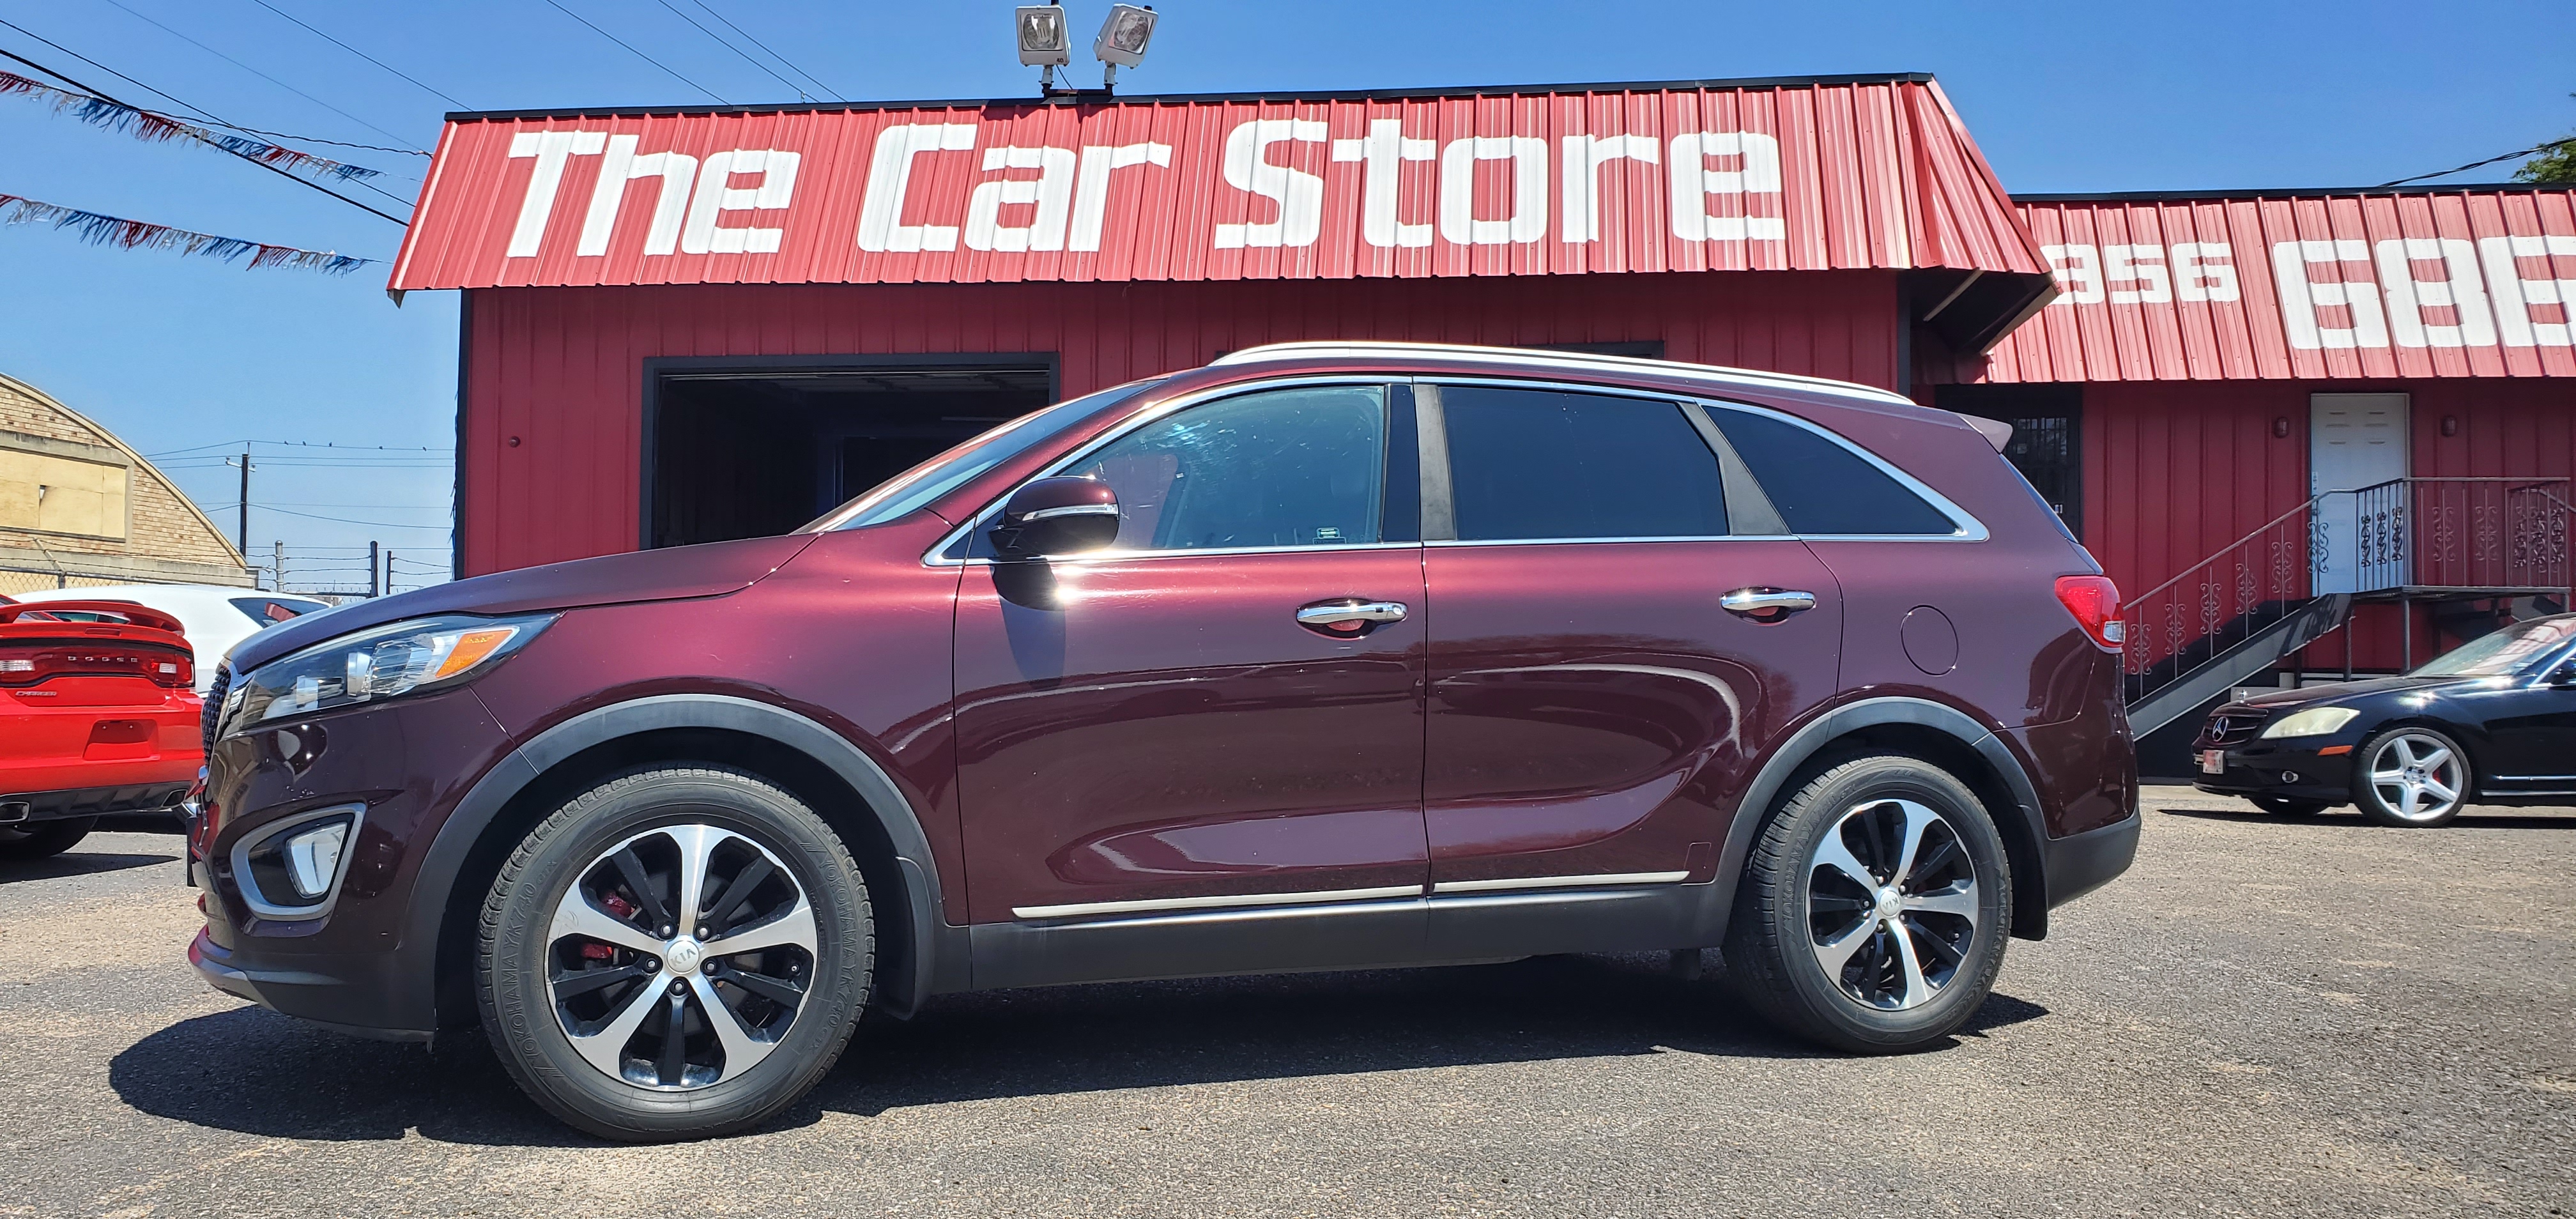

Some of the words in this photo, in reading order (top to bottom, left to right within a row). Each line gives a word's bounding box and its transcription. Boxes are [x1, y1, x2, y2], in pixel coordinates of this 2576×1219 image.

[508, 130, 801, 257] The
[857, 123, 1172, 252] Car
[1215, 118, 1785, 249] Store
[2040, 242, 2240, 305] 956
[503, 882, 537, 950] YK740
[818, 859, 857, 961] YOKOHAMA
[1882, 897, 1899, 910] KIA
[670, 948, 696, 967] KIA
[501, 953, 543, 1063] YOKOHAMA
[827, 963, 857, 1029] YK740
